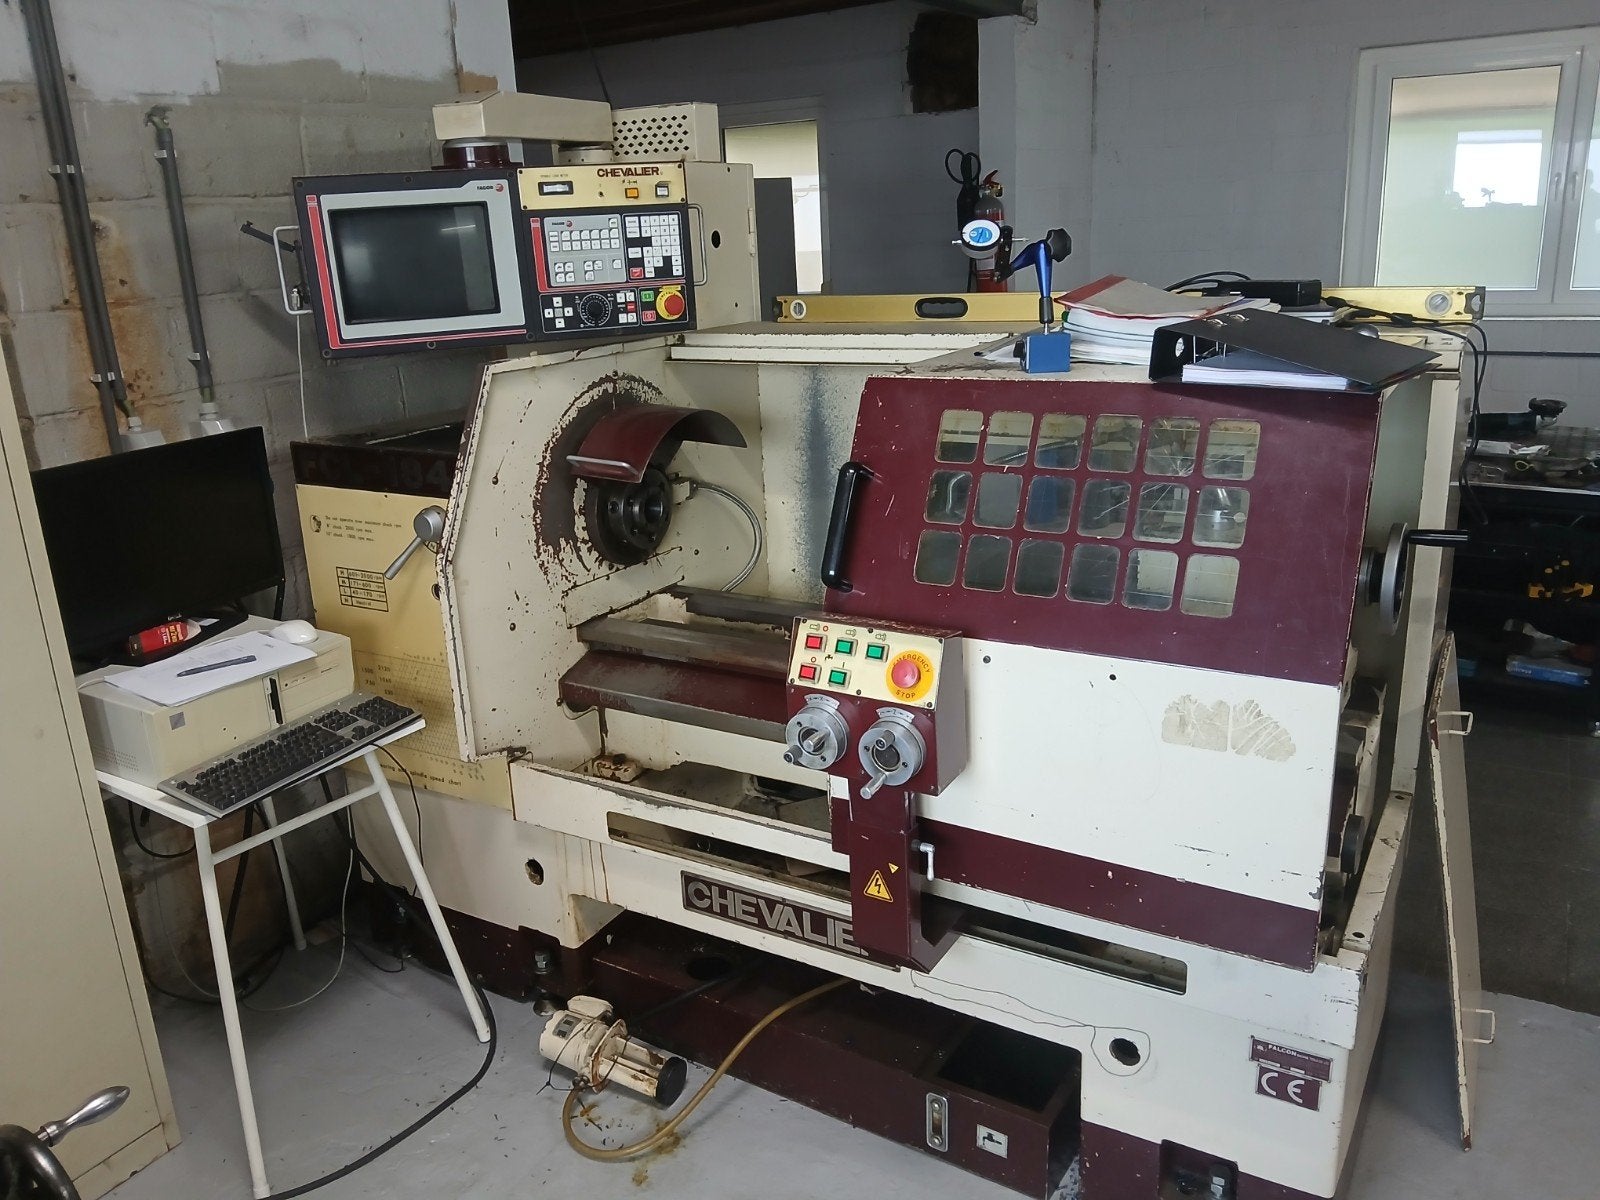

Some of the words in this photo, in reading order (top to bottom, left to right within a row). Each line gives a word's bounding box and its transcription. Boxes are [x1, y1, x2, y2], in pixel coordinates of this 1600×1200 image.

[597, 166, 660, 177] CHEVALIER
[892, 654, 930, 672] MERGENCY
[896, 690, 916, 698] STOP
[687, 880, 869, 957] CHEVALIE
[1268, 1044, 1297, 1057] FALCON
[1261, 1072, 1305, 1104] CE
